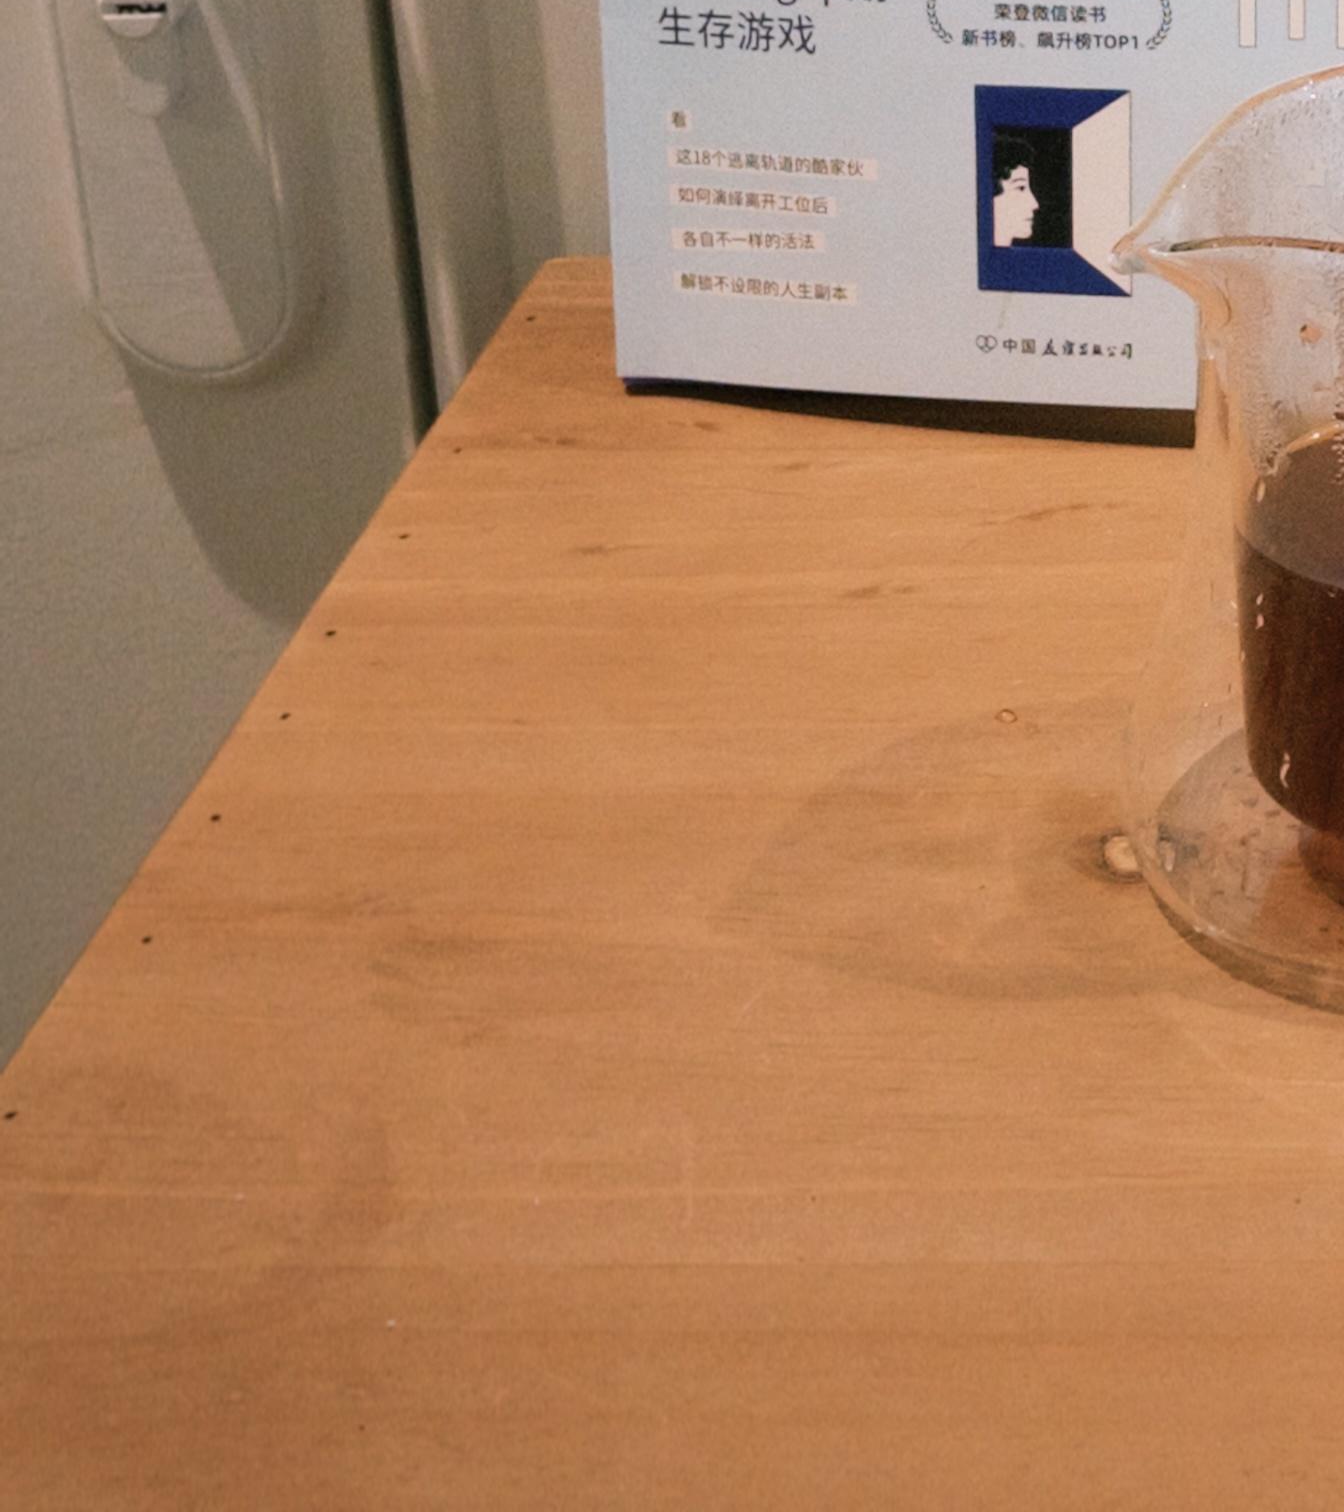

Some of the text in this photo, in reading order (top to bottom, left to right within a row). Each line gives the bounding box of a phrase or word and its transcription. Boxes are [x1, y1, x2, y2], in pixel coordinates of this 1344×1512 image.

[993, 2, 1107, 24] 荣登微信读书
[657, 5, 817, 55] 生存游戏
[676, 148, 864, 177] 这18个逃离轨道的酷家伙
[677, 187, 829, 215] 如何演绎离开工位后
[682, 230, 816, 250] 各自不一样的活法
[680, 272, 849, 301] 解锁不设限的人生副本
